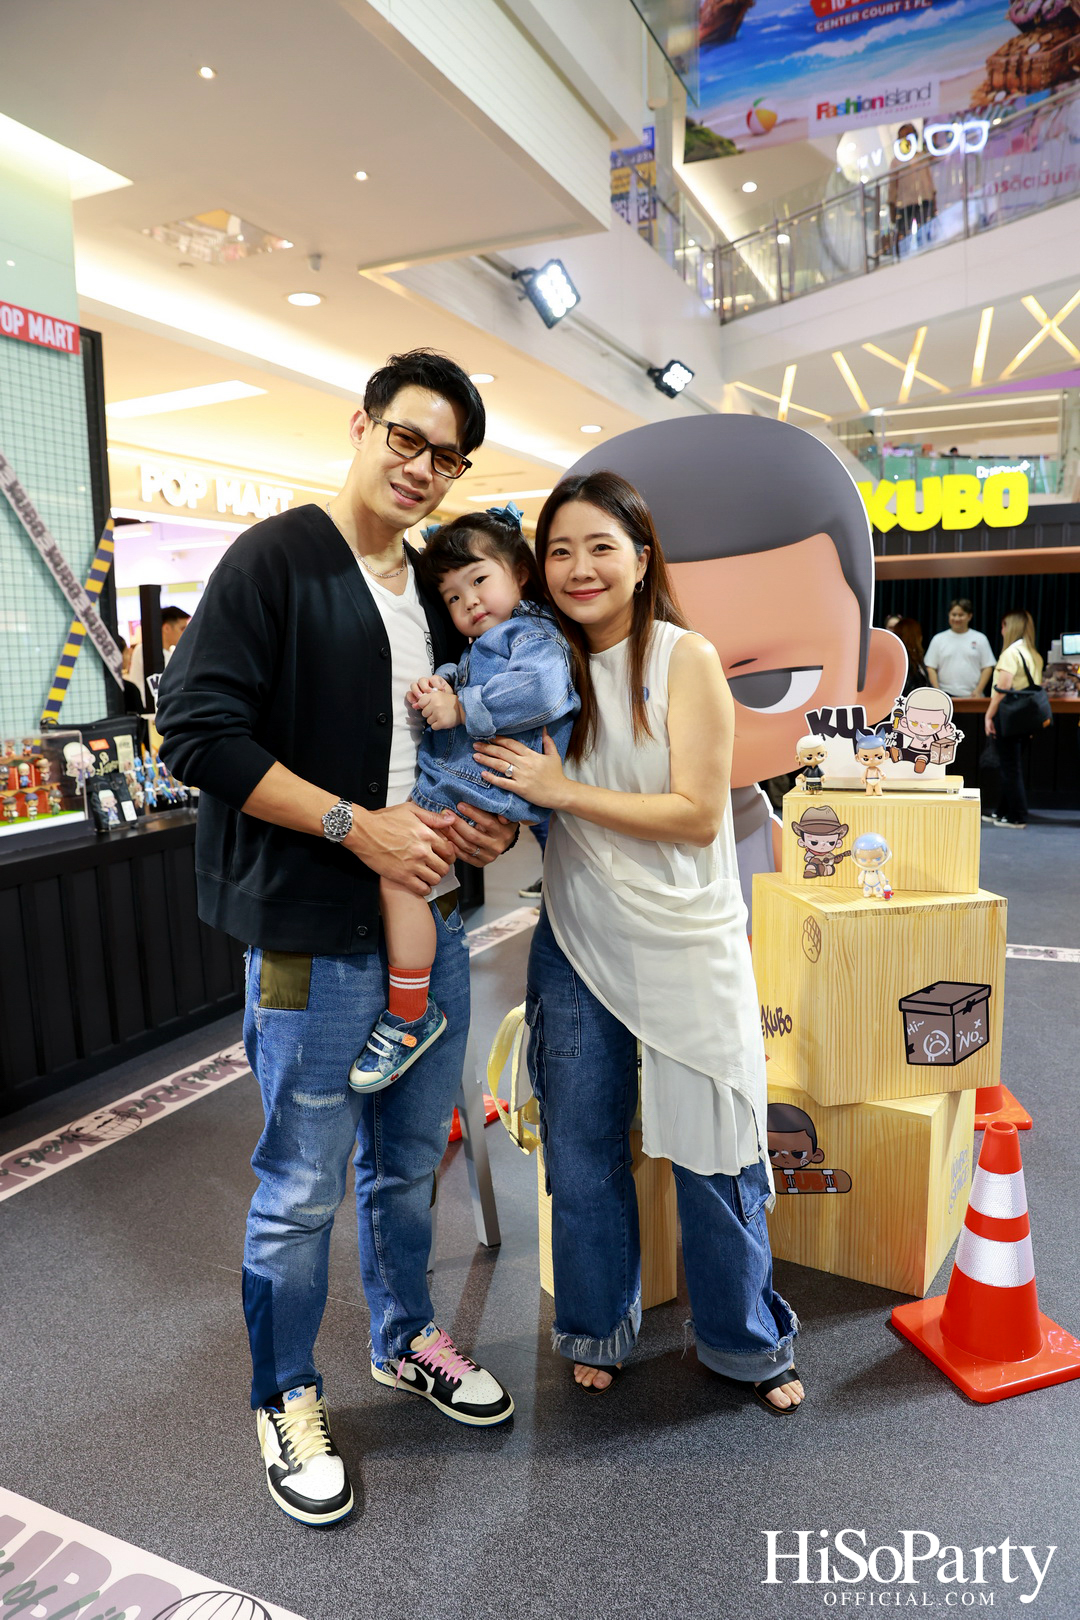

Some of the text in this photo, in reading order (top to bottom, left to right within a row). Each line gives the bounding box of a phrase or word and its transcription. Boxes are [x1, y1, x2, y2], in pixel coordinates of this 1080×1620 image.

[815, 11, 860, 33] CENTER
[861, 2, 901, 20] COURT
[29, 313, 75, 351] MART
[140, 465, 294, 519] POP MART
[857, 473, 1029, 533] KUBO
